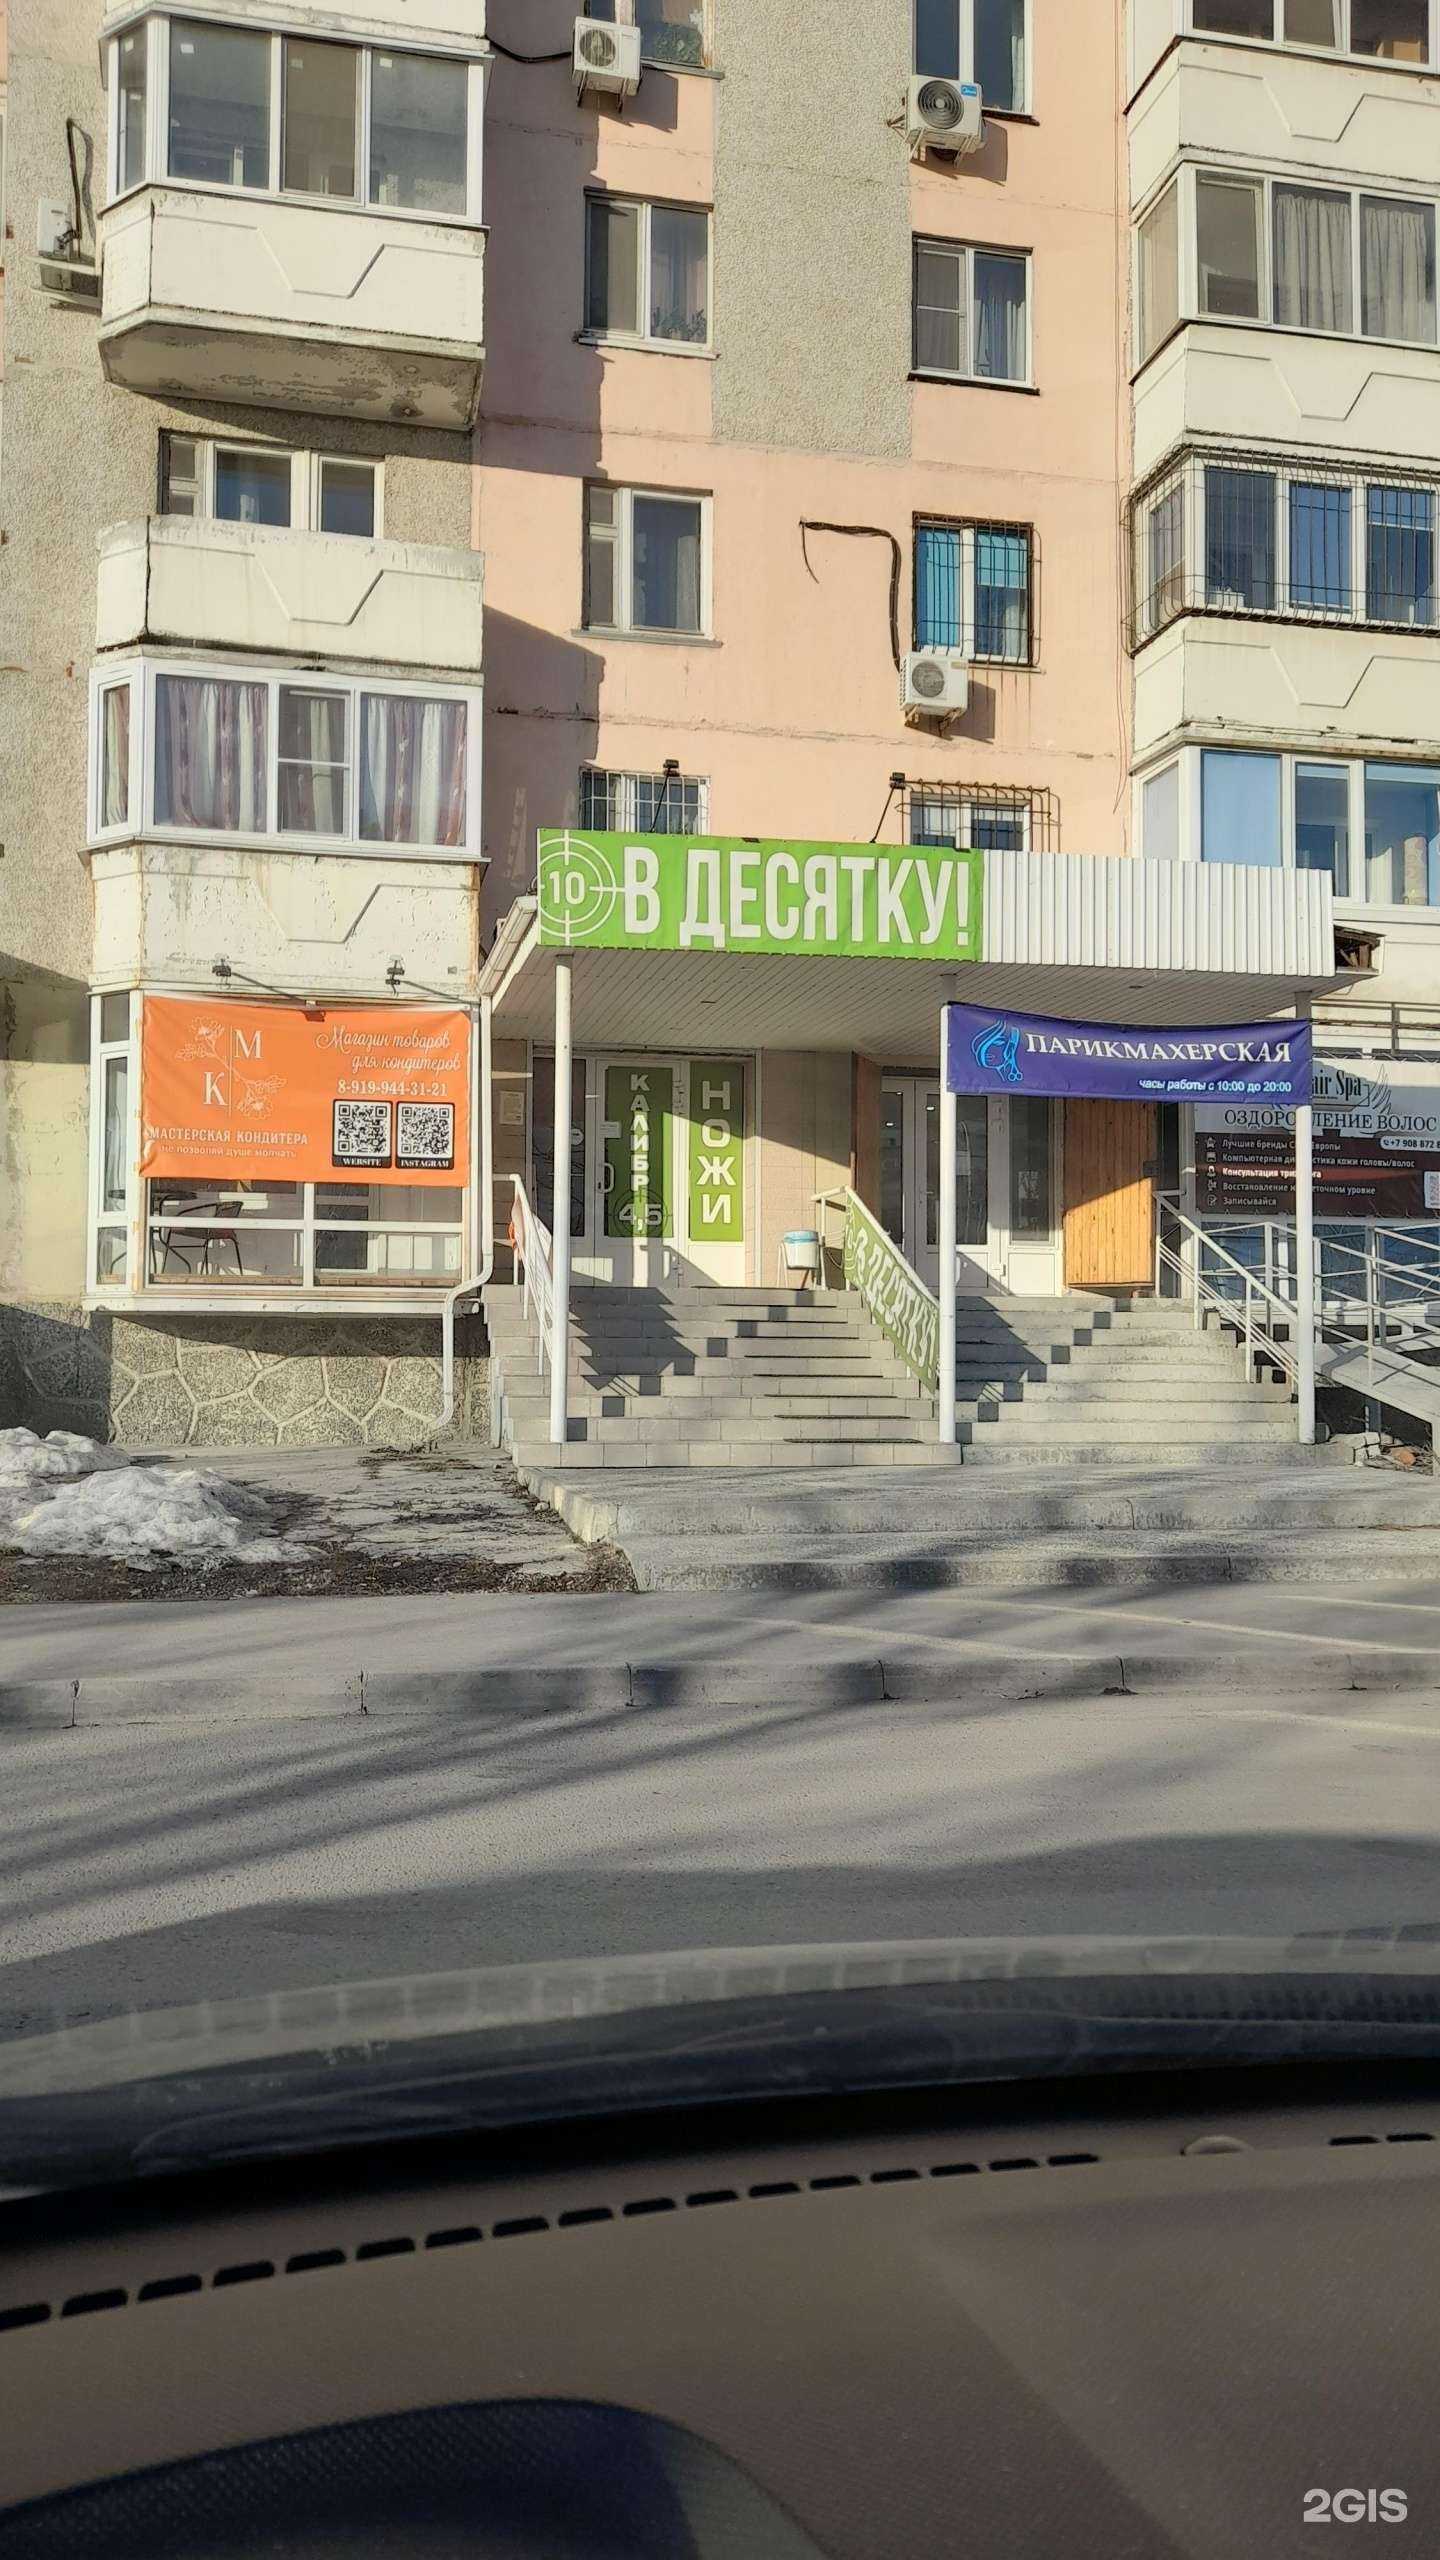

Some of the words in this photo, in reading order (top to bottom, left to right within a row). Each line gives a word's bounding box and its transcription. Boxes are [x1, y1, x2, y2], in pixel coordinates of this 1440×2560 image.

[549, 870, 585, 905] 10
[623, 846, 661, 935] В
[679, 848, 969, 948] ДЕСЯТКУ!
[315, 1024, 389, 1054] Магазин
[393, 1028, 449, 1054] товаров
[1024, 1033, 1292, 1063] ПАРИКМАХЕРСКАЯ
[352, 1055, 378, 1073] для
[382, 1053, 461, 1076] кондитеров
[338, 1079, 448, 1097] 8-919-944-31-21
[1139, 1079, 1165, 1089] часы
[1167, 1079, 1206, 1091] работы
[1217, 1080, 1245, 1091] 10:00
[1247, 1082, 1261, 1093] до
[1263, 1081, 1292, 1093] 20:00
[1312, 1069, 1332, 1095] air
[1336, 1069, 1361, 1101] Spa
[1224, 1109, 1373, 1129] ОЗДОРОЛЕНИЕ
[1378, 1114, 1437, 1131] ВОЛОС
[150, 1126, 231, 1142] МАСТЕРСКАЯ
[237, 1130, 308, 1145] КОНДИТЕРА
[630, 1074, 650, 1192] КАЛИБР
[696, 1080, 737, 1225] НОЖИ
[1222, 1140, 1255, 1149] Лучшие
[1256, 1140, 1287, 1150] бренды
[343, 1158, 381, 1166] WEBSITE
[401, 1159, 449, 1168] INSTAGRAM
[1222, 1154, 1283, 1164] Компьютерная
[1222, 1168, 1279, 1178] Консультация
[1223, 1182, 1289, 1192] Восстановление
[1223, 1197, 1277, 1206] Записывайся
